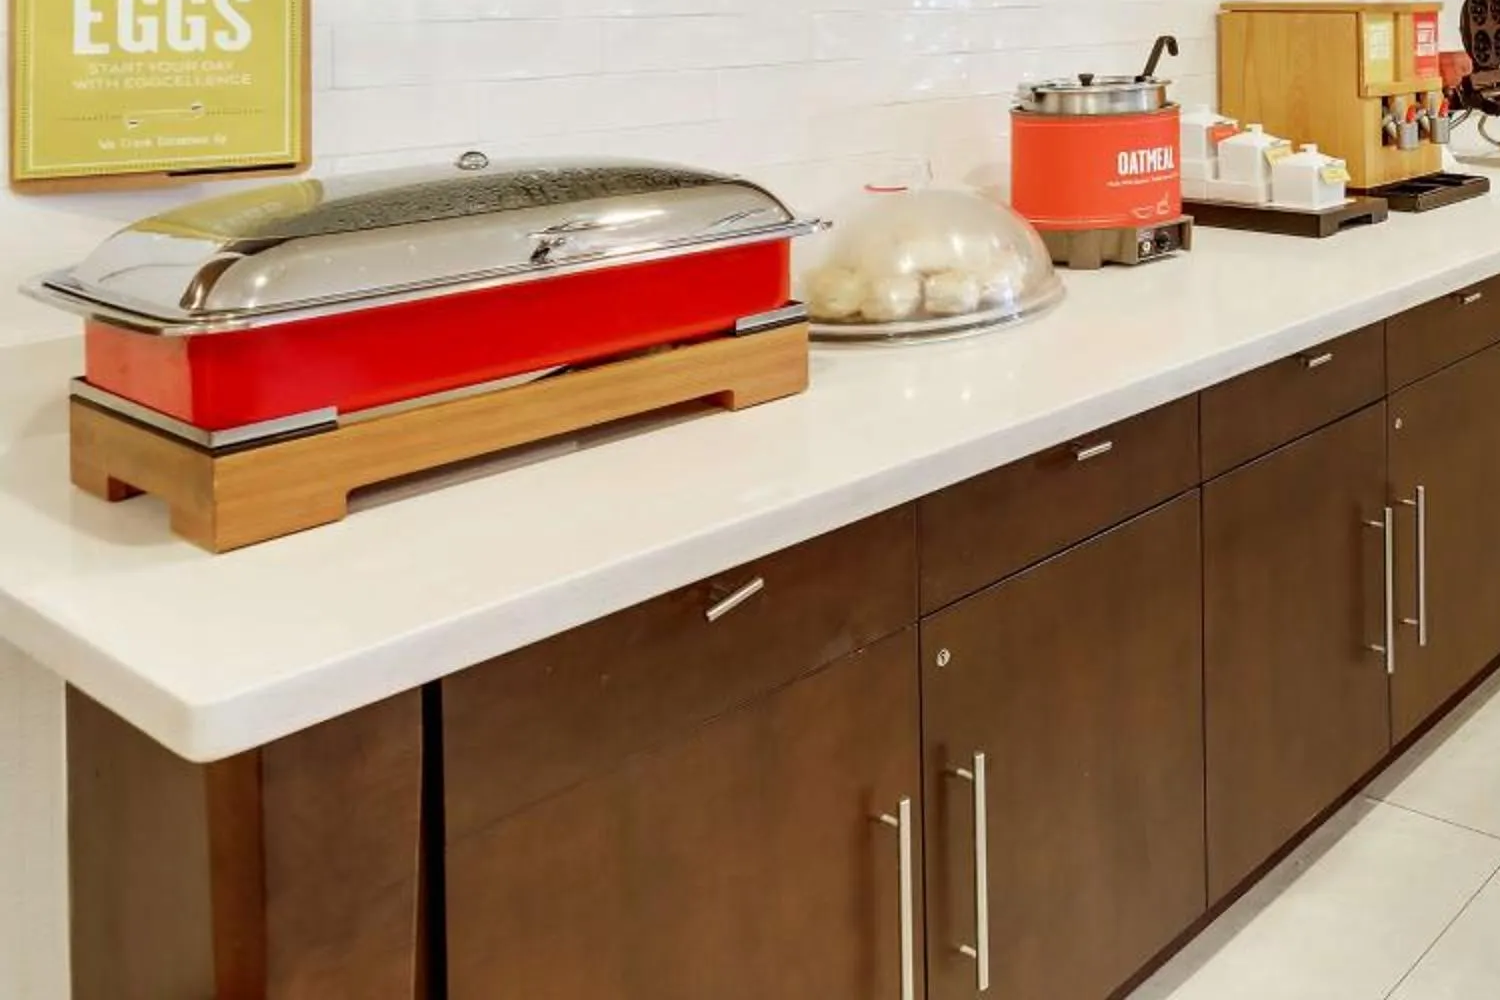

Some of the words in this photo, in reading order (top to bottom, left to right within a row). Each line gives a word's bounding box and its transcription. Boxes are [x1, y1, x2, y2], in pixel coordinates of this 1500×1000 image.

[89, 61, 144, 76] START
[73, 77, 120, 90] WITH
[1117, 145, 1175, 176] OATMEAL
